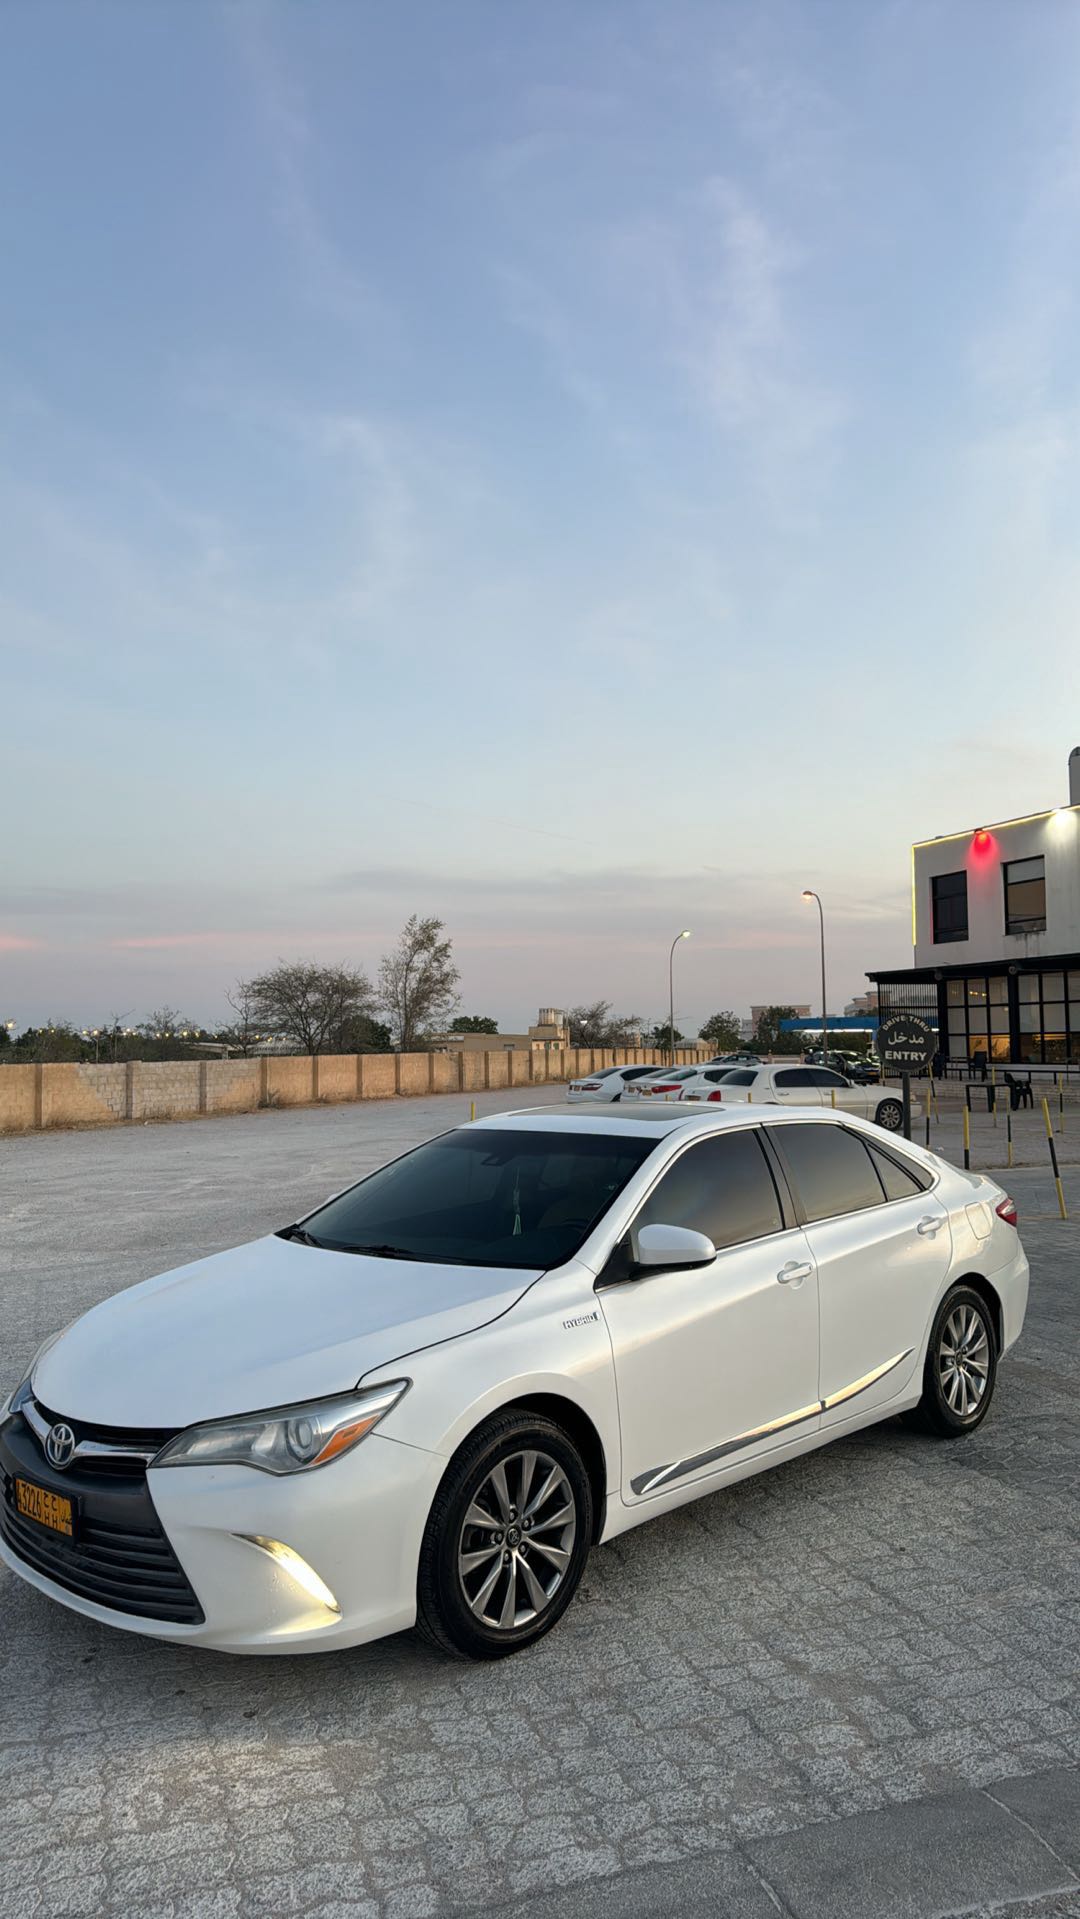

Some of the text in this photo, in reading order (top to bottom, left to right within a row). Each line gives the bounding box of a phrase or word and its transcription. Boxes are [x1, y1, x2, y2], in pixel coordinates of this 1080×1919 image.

[882, 1015, 930, 1032] DRIVE THRU
[888, 1031, 925, 1045] مدخل
[885, 1050, 927, 1061] ENTRY
[563, 1314, 595, 1329] HYBRID
